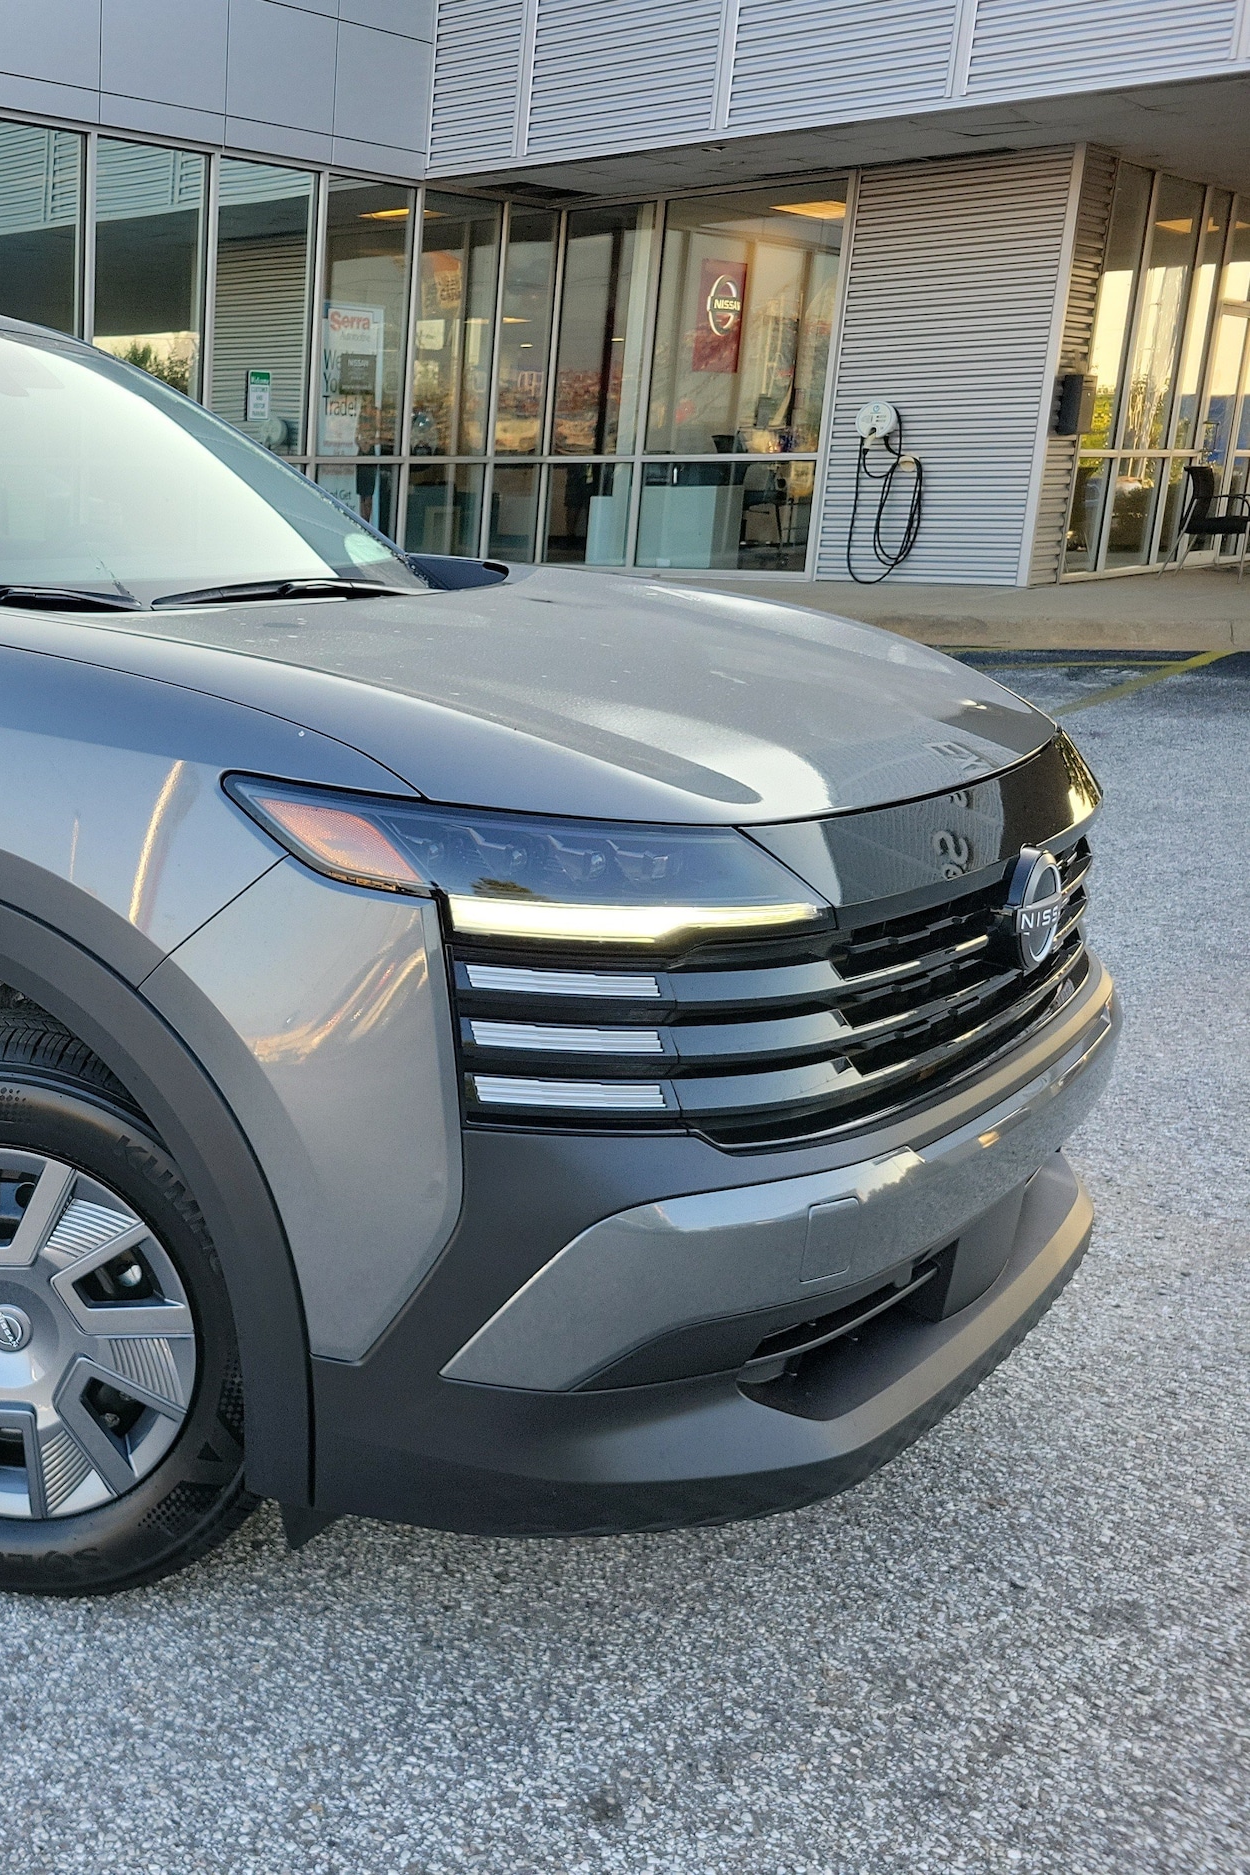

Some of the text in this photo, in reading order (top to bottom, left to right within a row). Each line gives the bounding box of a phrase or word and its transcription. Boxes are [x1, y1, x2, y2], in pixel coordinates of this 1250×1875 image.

[713, 298, 741, 311] NISSAN
[330, 310, 370, 331] Serra
[323, 348, 341, 370] We
[323, 372, 339, 393] Yo
[322, 394, 357, 417] Trade!
[1020, 905, 1061, 930] NISS
